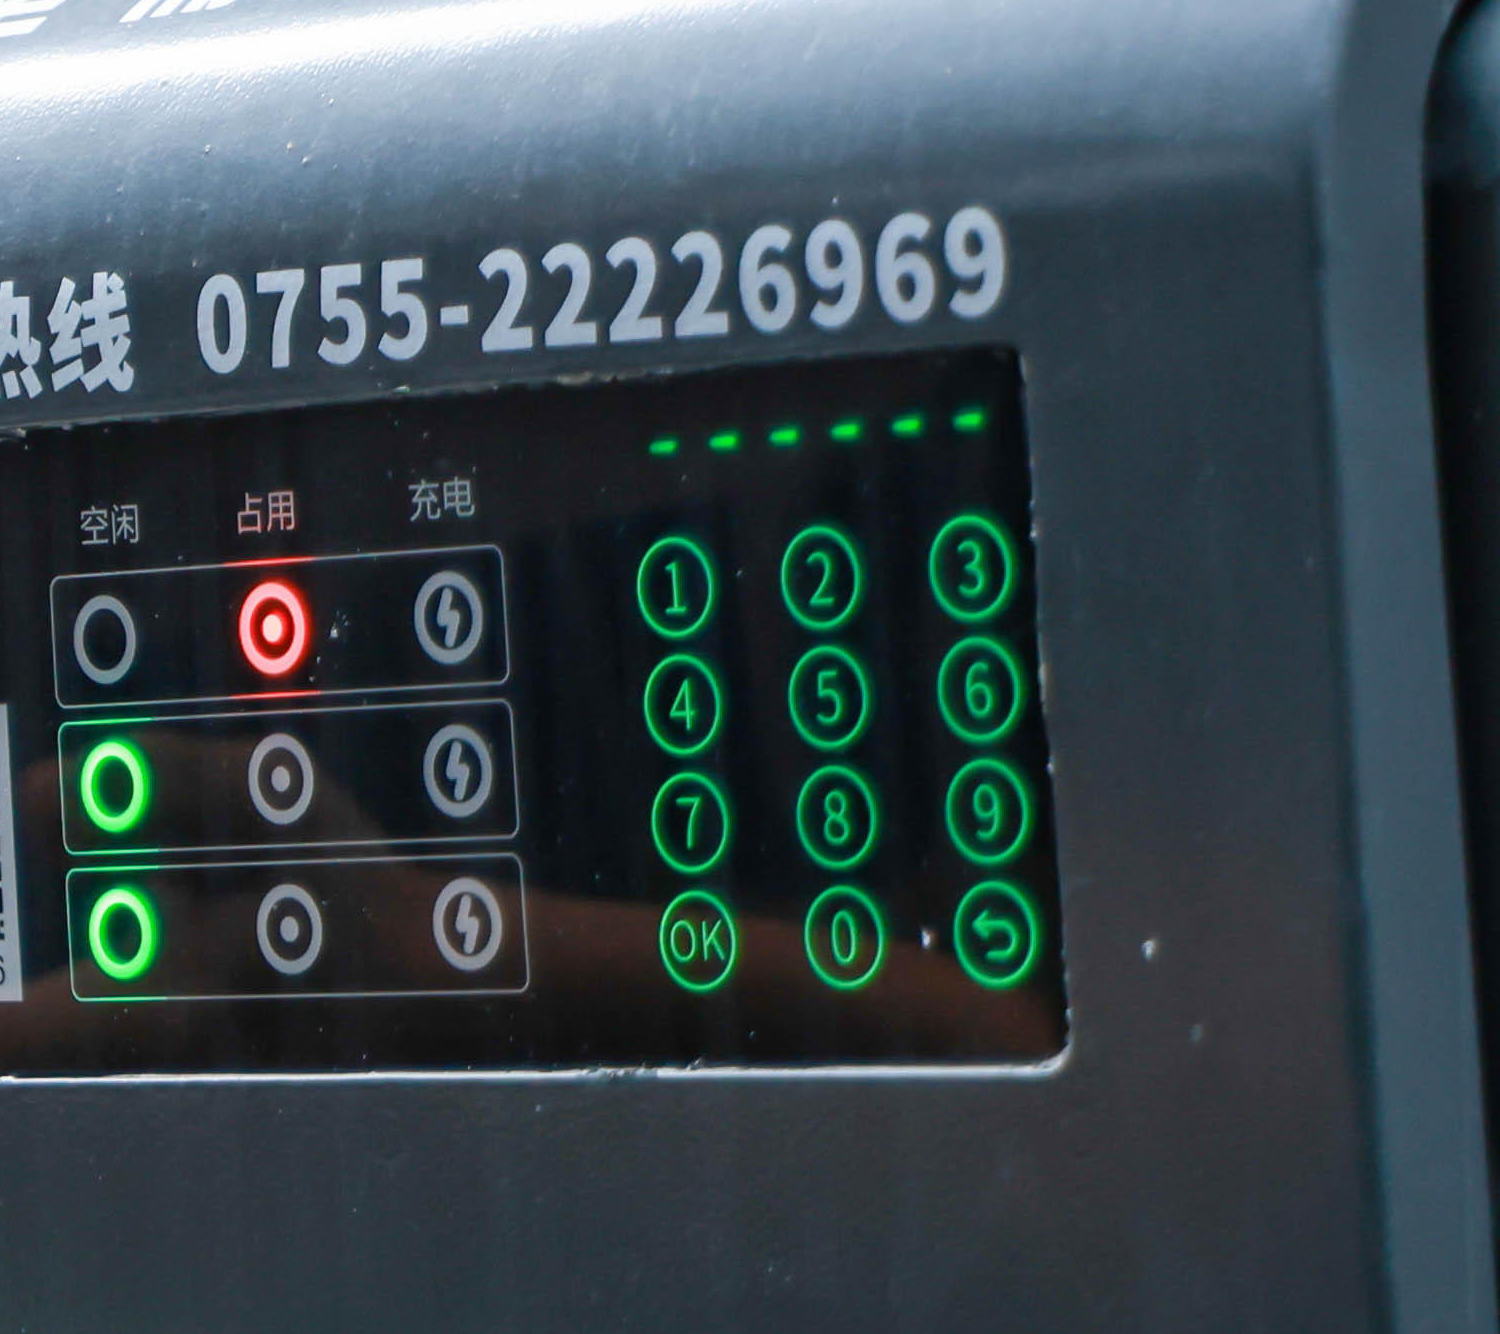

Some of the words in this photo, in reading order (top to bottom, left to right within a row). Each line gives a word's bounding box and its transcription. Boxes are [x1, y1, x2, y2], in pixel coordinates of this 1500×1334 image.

[197, 205, 1006, 375] 0755-22226969
[79, 504, 140, 545] 空闲
[237, 490, 296, 534] 占用
[407, 476, 476, 522] 充电
[669, 919, 725, 962] OK
